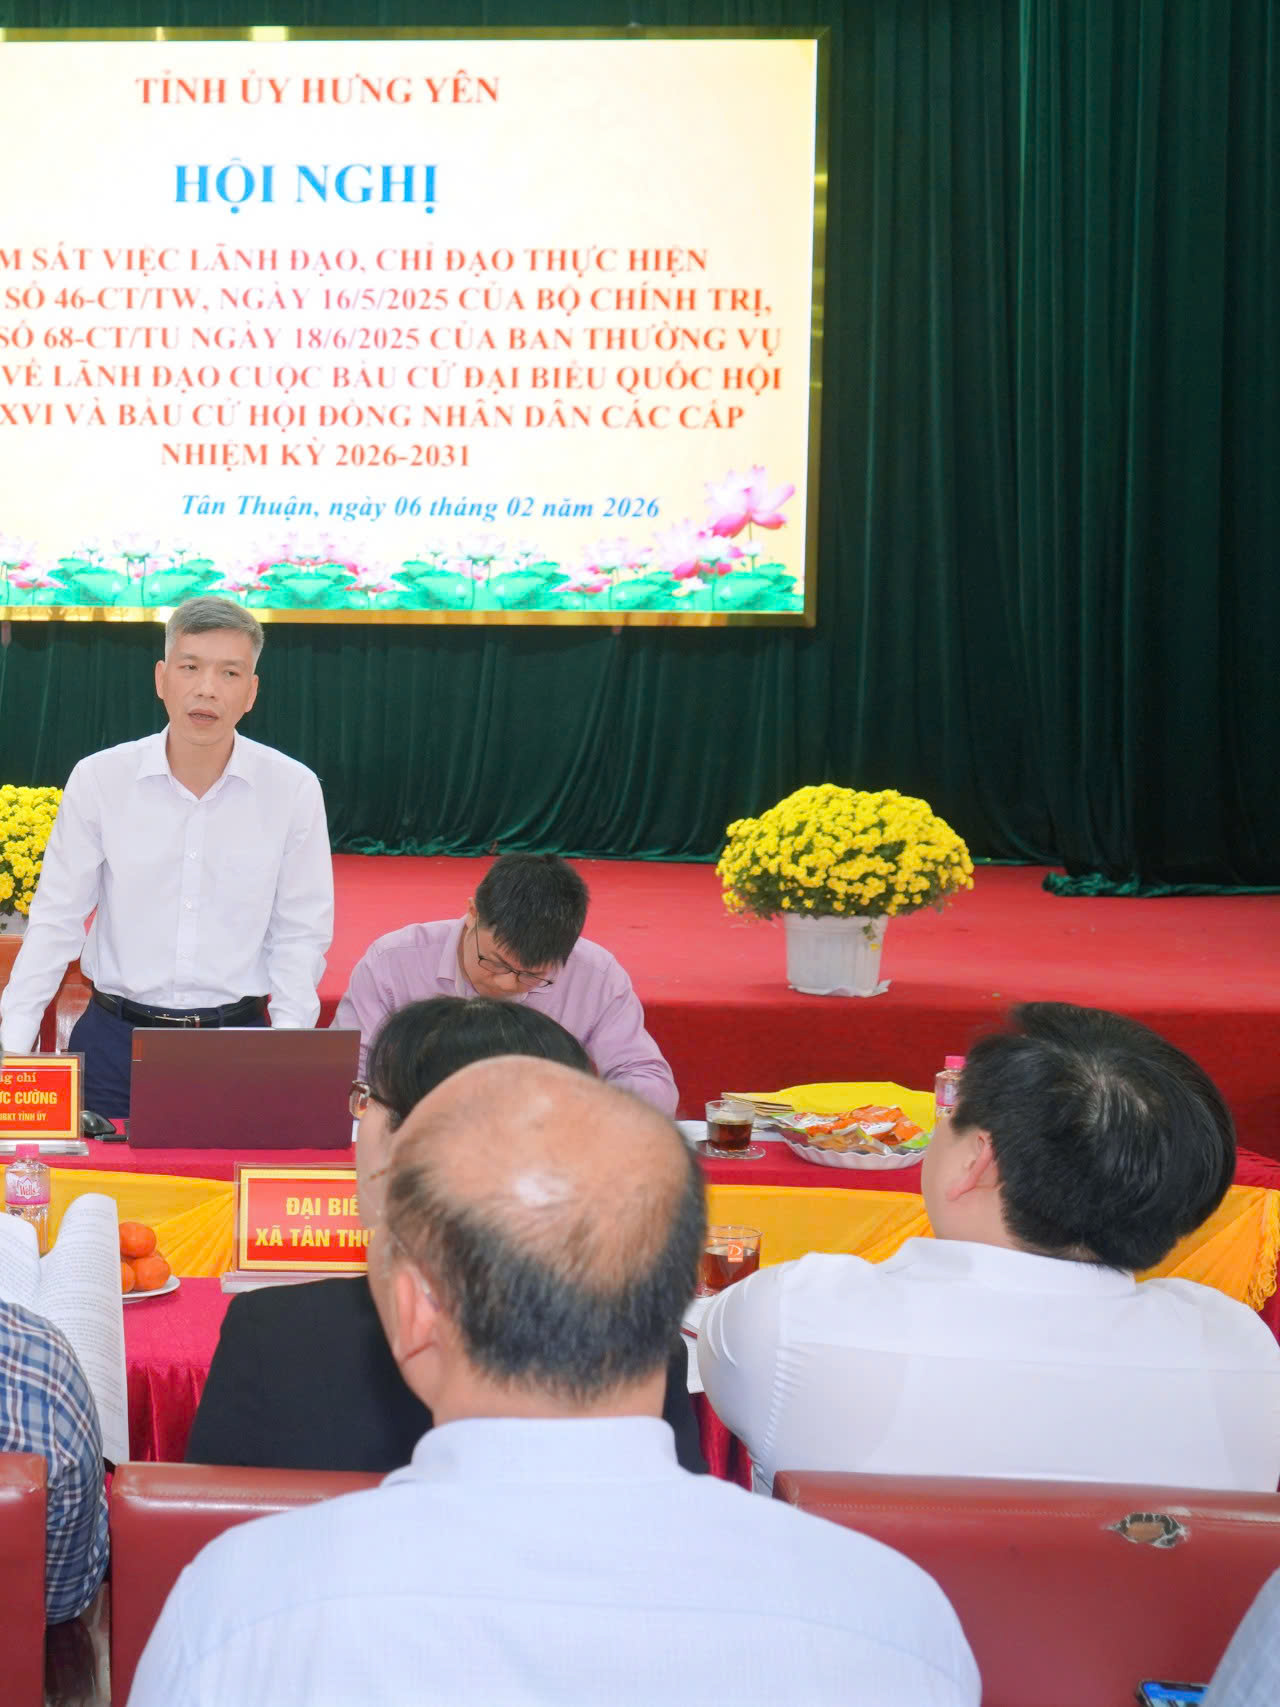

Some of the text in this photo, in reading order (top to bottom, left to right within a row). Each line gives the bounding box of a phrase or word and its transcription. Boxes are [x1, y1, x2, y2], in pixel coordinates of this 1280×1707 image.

[135, 69, 499, 104] TỈNH ỦY HƯNG YÊN
[175, 157, 439, 215] HỘI NGHỊ
[32, 241, 91, 271] SÁT
[103, 246, 179, 277] VIỆC
[190, 243, 278, 272] LÃNH
[289, 248, 366, 277] ĐẠO,
[376, 242, 433, 272] CHỈ
[446, 248, 514, 278] ĐẠO
[523, 245, 617, 279] THỰC
[629, 247, 708, 279] HIỆN
[5, 280, 45, 310] SỐ
[54, 287, 209, 313] 46-CT/TW,
[221, 281, 307, 310] NGÀY
[324, 287, 449, 311] 16/5/2025
[459, 281, 526, 311] CỦA
[537, 285, 581, 318] BỘ
[590, 280, 696, 312] CHÍNH
[708, 287, 773, 318] TRỊ,
[44, 326, 179, 350] 68-CT/TU
[192, 320, 278, 350] NGÀY
[296, 327, 420, 350] 18/6/2025
[430, 320, 497, 351] CỦA
[509, 327, 573, 351] BAN
[584, 320, 726, 352] THƯỜNG
[738, 327, 782, 358] VỤ
[2, 357, 42, 388] VỀ
[54, 359, 141, 388] LÃNH
[153, 365, 220, 394] ĐẠO
[229, 364, 321, 394] CUỘC
[333, 360, 396, 389] BẦU
[407, 360, 457, 389] CỬ
[465, 366, 520, 395] ĐẠI
[531, 361, 606, 391] BIỂU
[616, 360, 713, 396] QUỐC
[723, 364, 783, 396] HỘI
[0, 403, 53, 426] XVI
[65, 397, 107, 427] VÀ
[119, 398, 182, 427] BẦU
[192, 398, 241, 427] CỬ
[249, 402, 307, 433] HỘI
[319, 399, 412, 428] ĐỒNG
[424, 398, 513, 428] NHÂN
[525, 399, 591, 428] DÂN
[601, 399, 671, 429] CÁC
[679, 400, 745, 430] CẤP
[162, 436, 469, 472] NHIỆM KỲ 2026-2031
[182, 493, 660, 523] Tân Thuận, ngày 06 tháng 02 năm 2026
[16, 1072, 37, 1083] chí
[14, 1089, 57, 1105] CƯỜNG
[286, 1197, 321, 1219] ĐẠI
[255, 1225, 283, 1247] XÃ
[289, 1225, 330, 1247] TÂN
